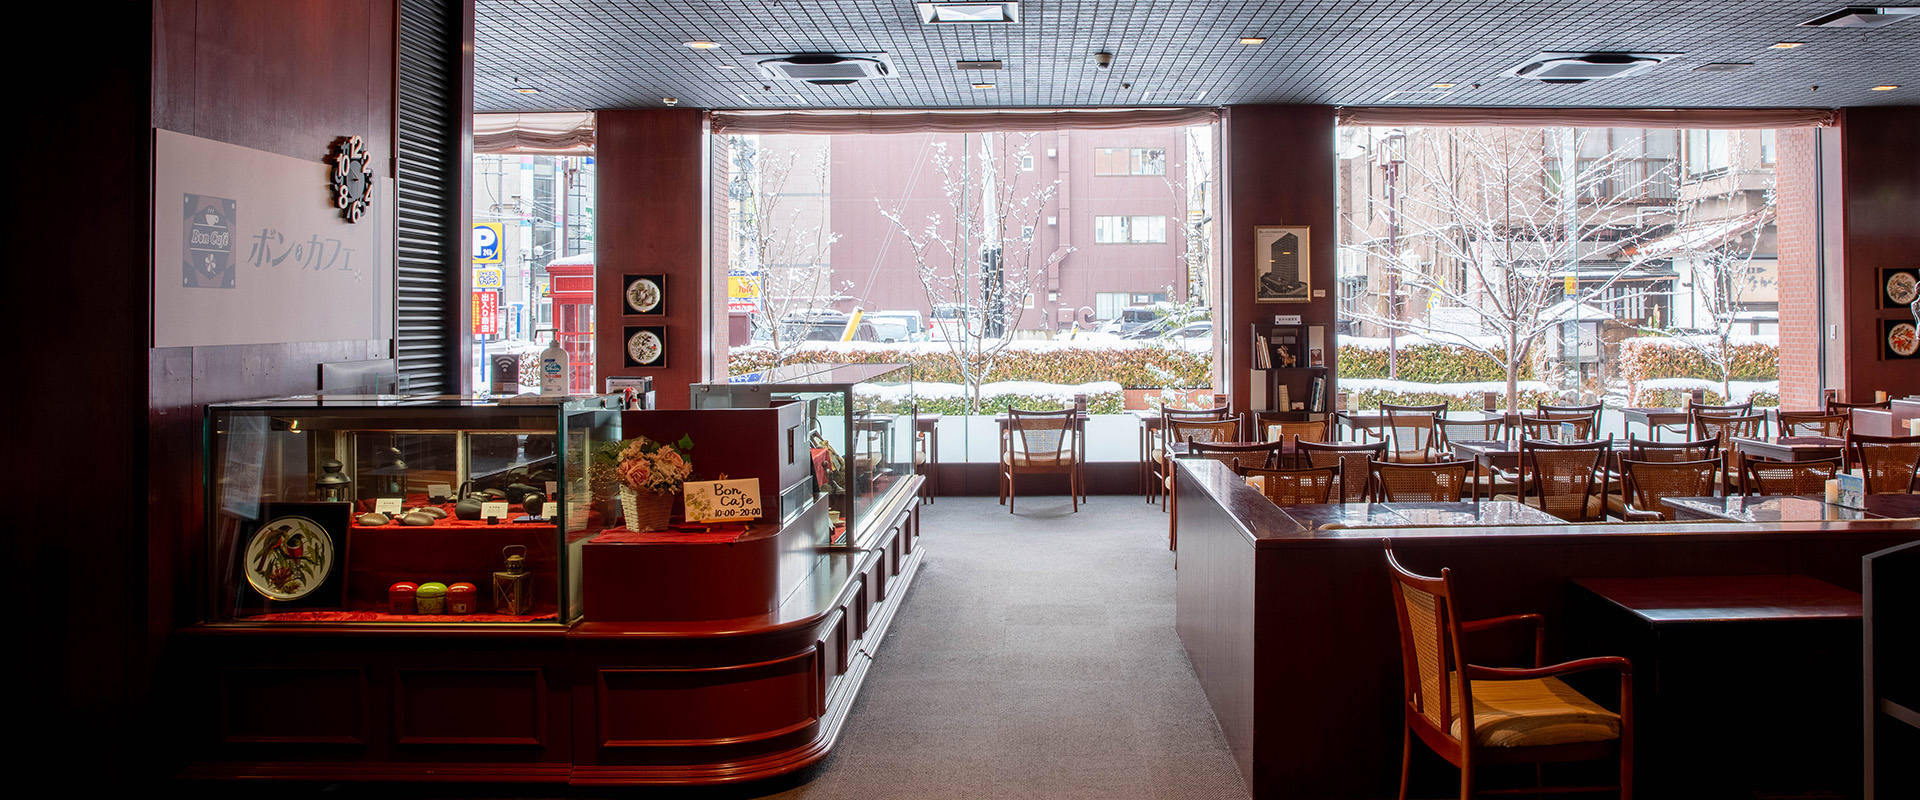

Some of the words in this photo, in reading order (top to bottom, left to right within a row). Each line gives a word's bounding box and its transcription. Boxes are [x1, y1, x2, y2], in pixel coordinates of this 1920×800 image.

[350, 135, 362, 159] 12
[336, 153, 350, 177] 10
[361, 151, 371, 174] 2
[338, 185, 349, 209] 8
[364, 184, 373, 203] 4
[351, 199, 361, 224] 6
[191, 229, 210, 245] Bon
[210, 230, 230, 249] Café
[473, 228, 496, 257] P
[481, 293, 489, 333] 出入り自由
[713, 482, 742, 496] Bon
[720, 493, 754, 508] Cafe
